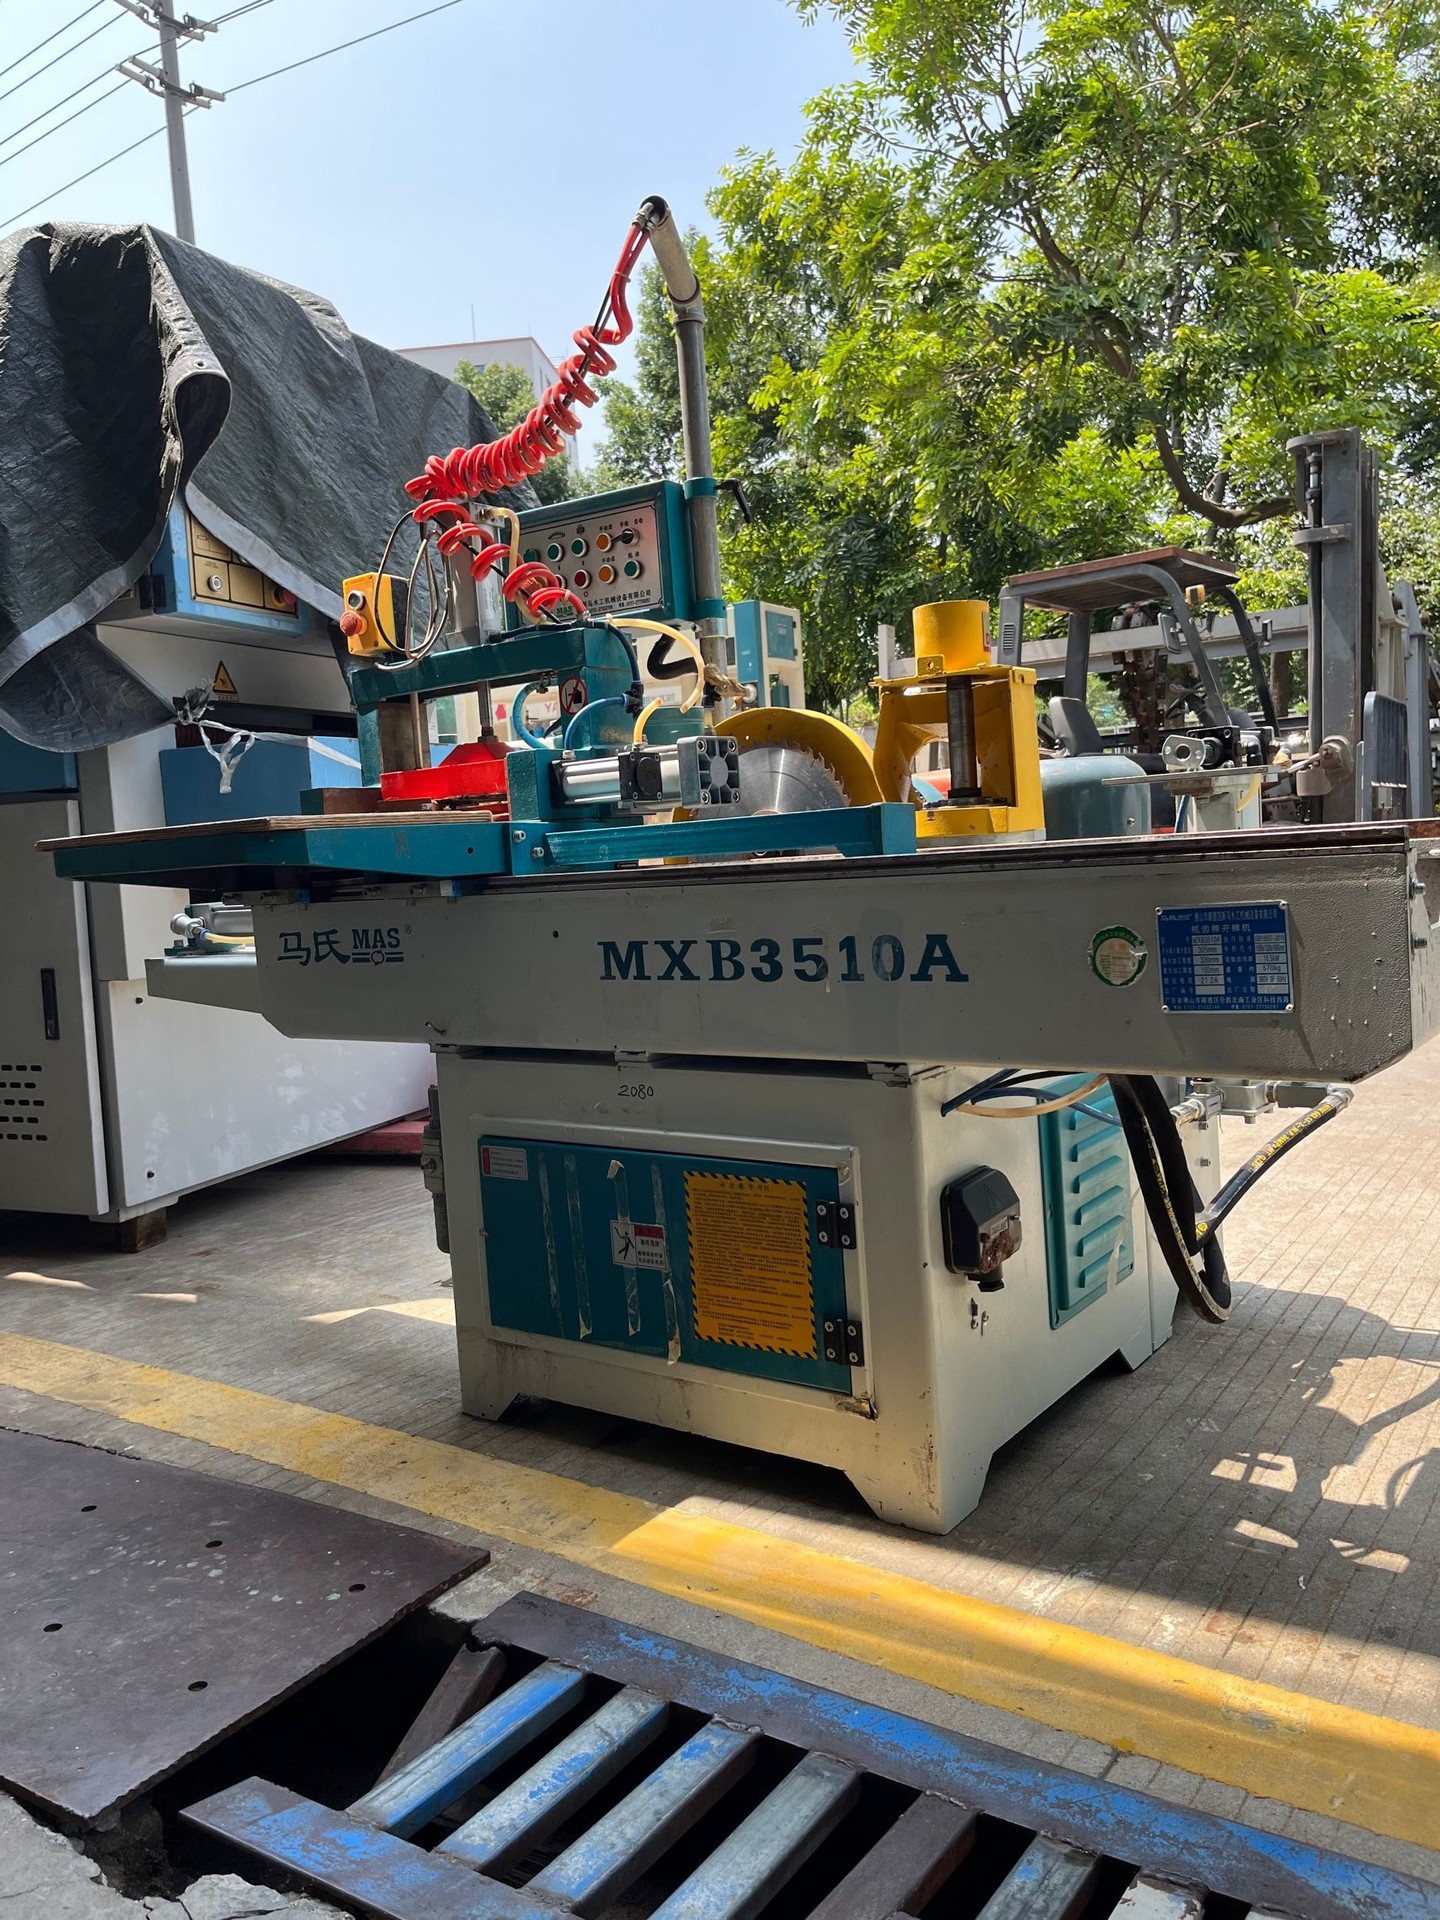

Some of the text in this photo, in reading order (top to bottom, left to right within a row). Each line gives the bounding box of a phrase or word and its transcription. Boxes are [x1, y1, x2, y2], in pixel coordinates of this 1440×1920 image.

[277, 927, 401, 967] 马氏 MAS
[597, 933, 970, 983] MXB3510A
[618, 1084, 655, 1100] 2080
